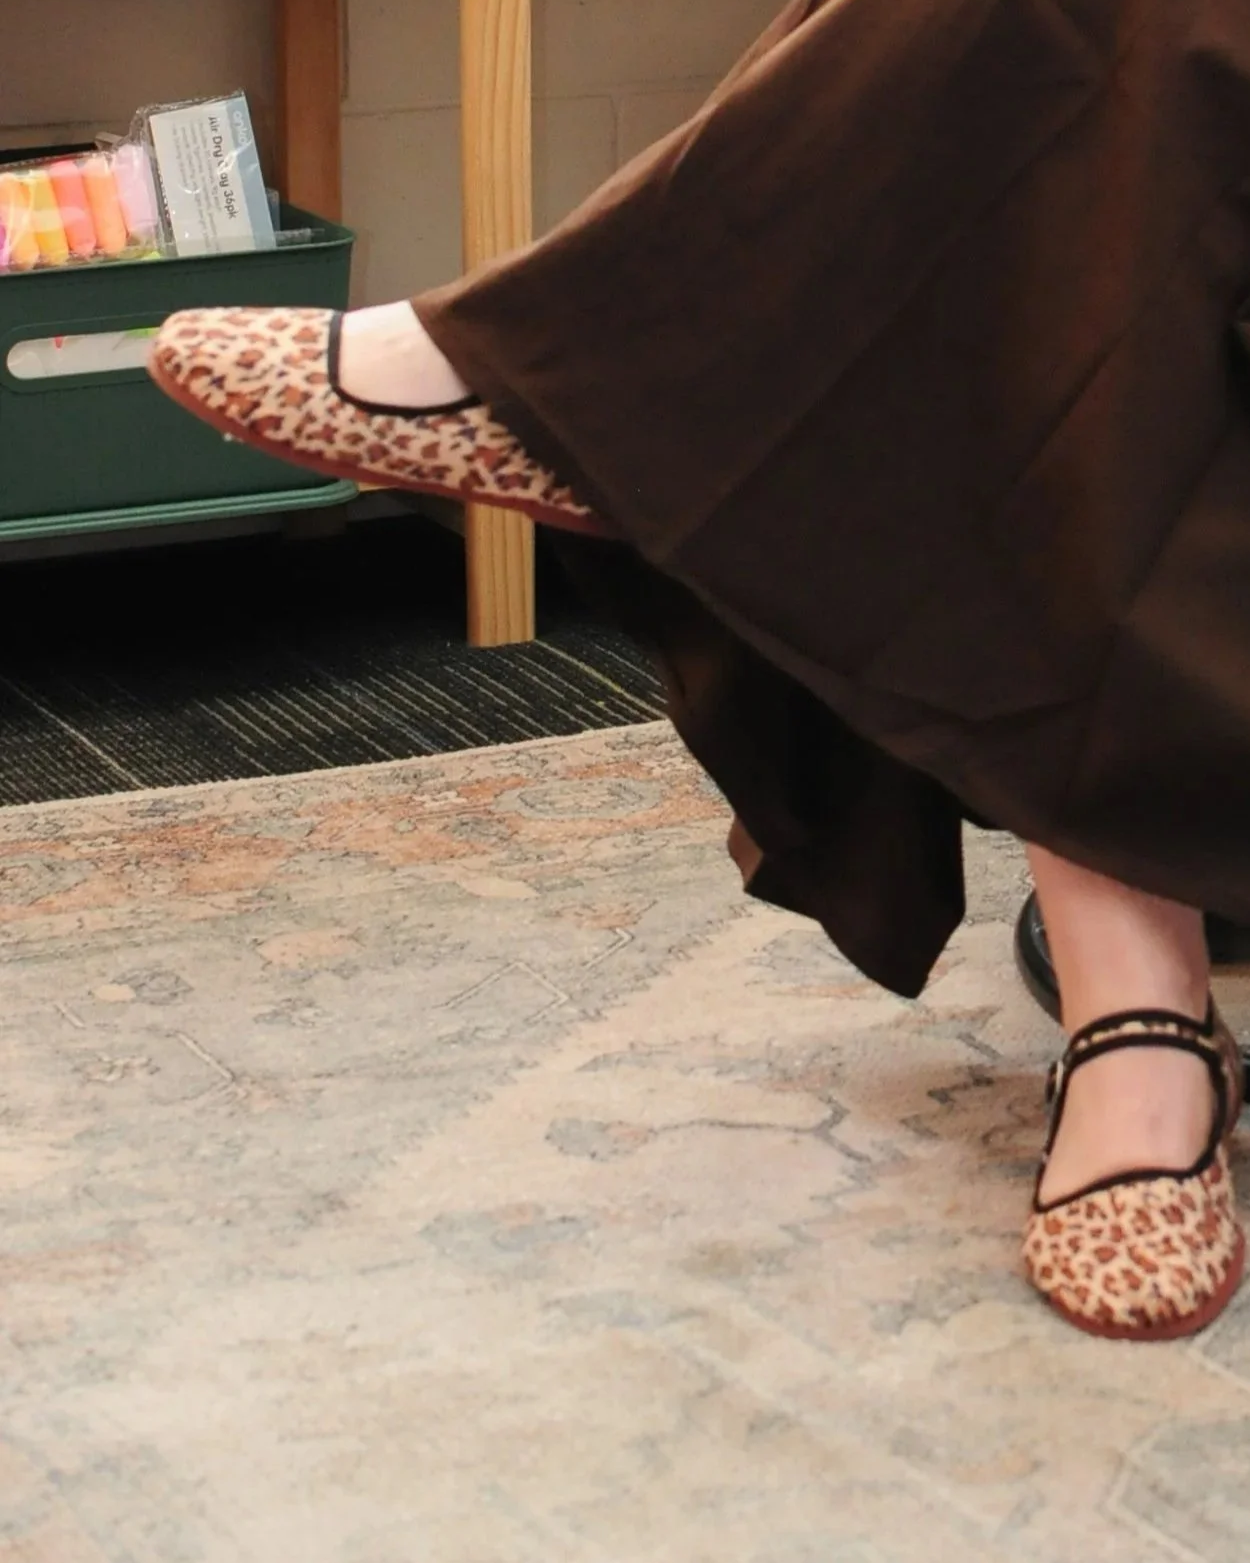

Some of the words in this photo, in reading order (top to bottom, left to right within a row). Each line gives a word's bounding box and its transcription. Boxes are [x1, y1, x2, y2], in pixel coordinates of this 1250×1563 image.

[208, 116, 220, 132] Air
[212, 135, 223, 158] Dry
[224, 190, 239, 220] 36pk
